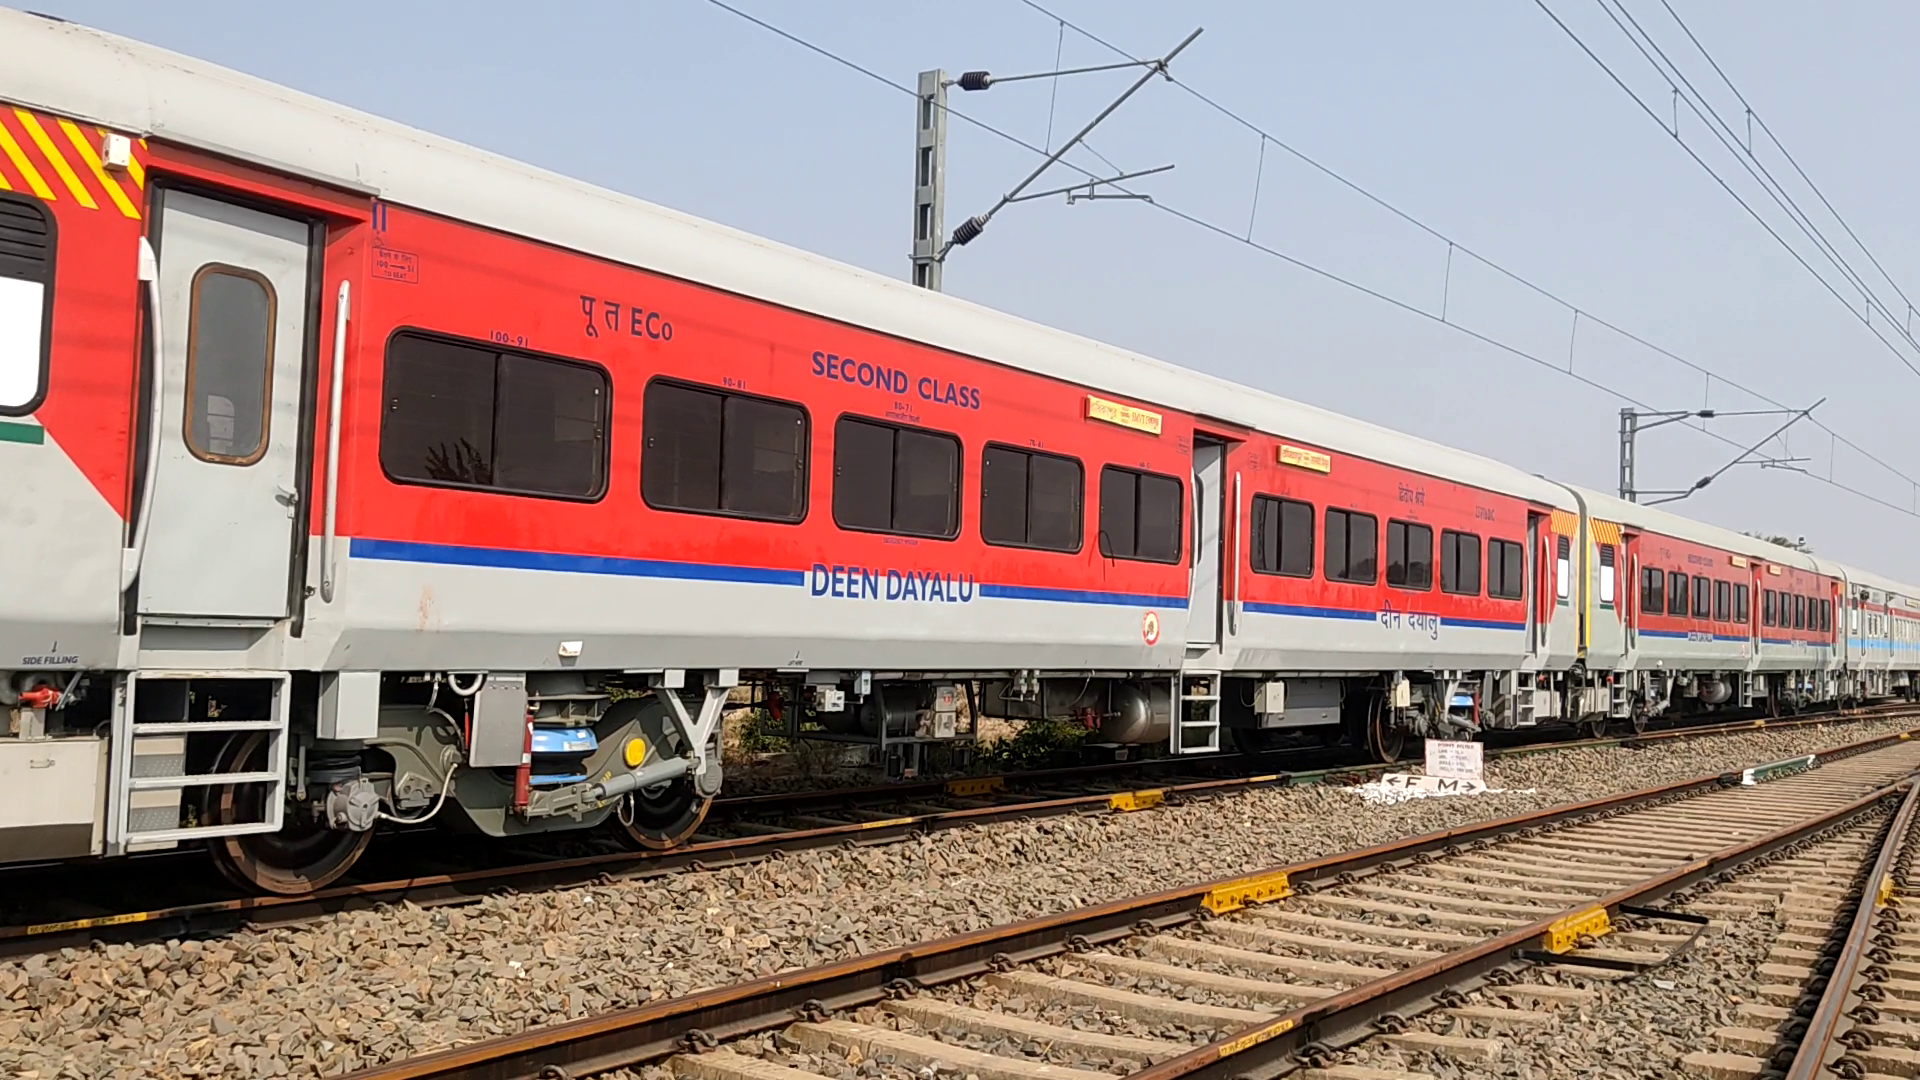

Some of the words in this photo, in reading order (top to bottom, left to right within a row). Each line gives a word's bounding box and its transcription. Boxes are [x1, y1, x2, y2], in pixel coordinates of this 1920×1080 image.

[580, 295, 599, 338] पू
[604, 300, 620, 332] त
[630, 307, 673, 341] ECo
[490, 330, 529, 348] 100-91
[722, 376, 746, 390] 90-81
[812, 351, 909, 394] SECOND
[918, 377, 981, 410] CLASS
[811, 563, 879, 600] DEEN
[886, 569, 974, 602] DAYALU
[1380, 599, 1401, 629] दीन
[1407, 611, 1440, 640] दयालु
[22, 656, 43, 665] SIDE
[44, 655, 79, 665] FILLING
[1405, 776, 1422, 789] F
[1438, 779, 1459, 792] M
